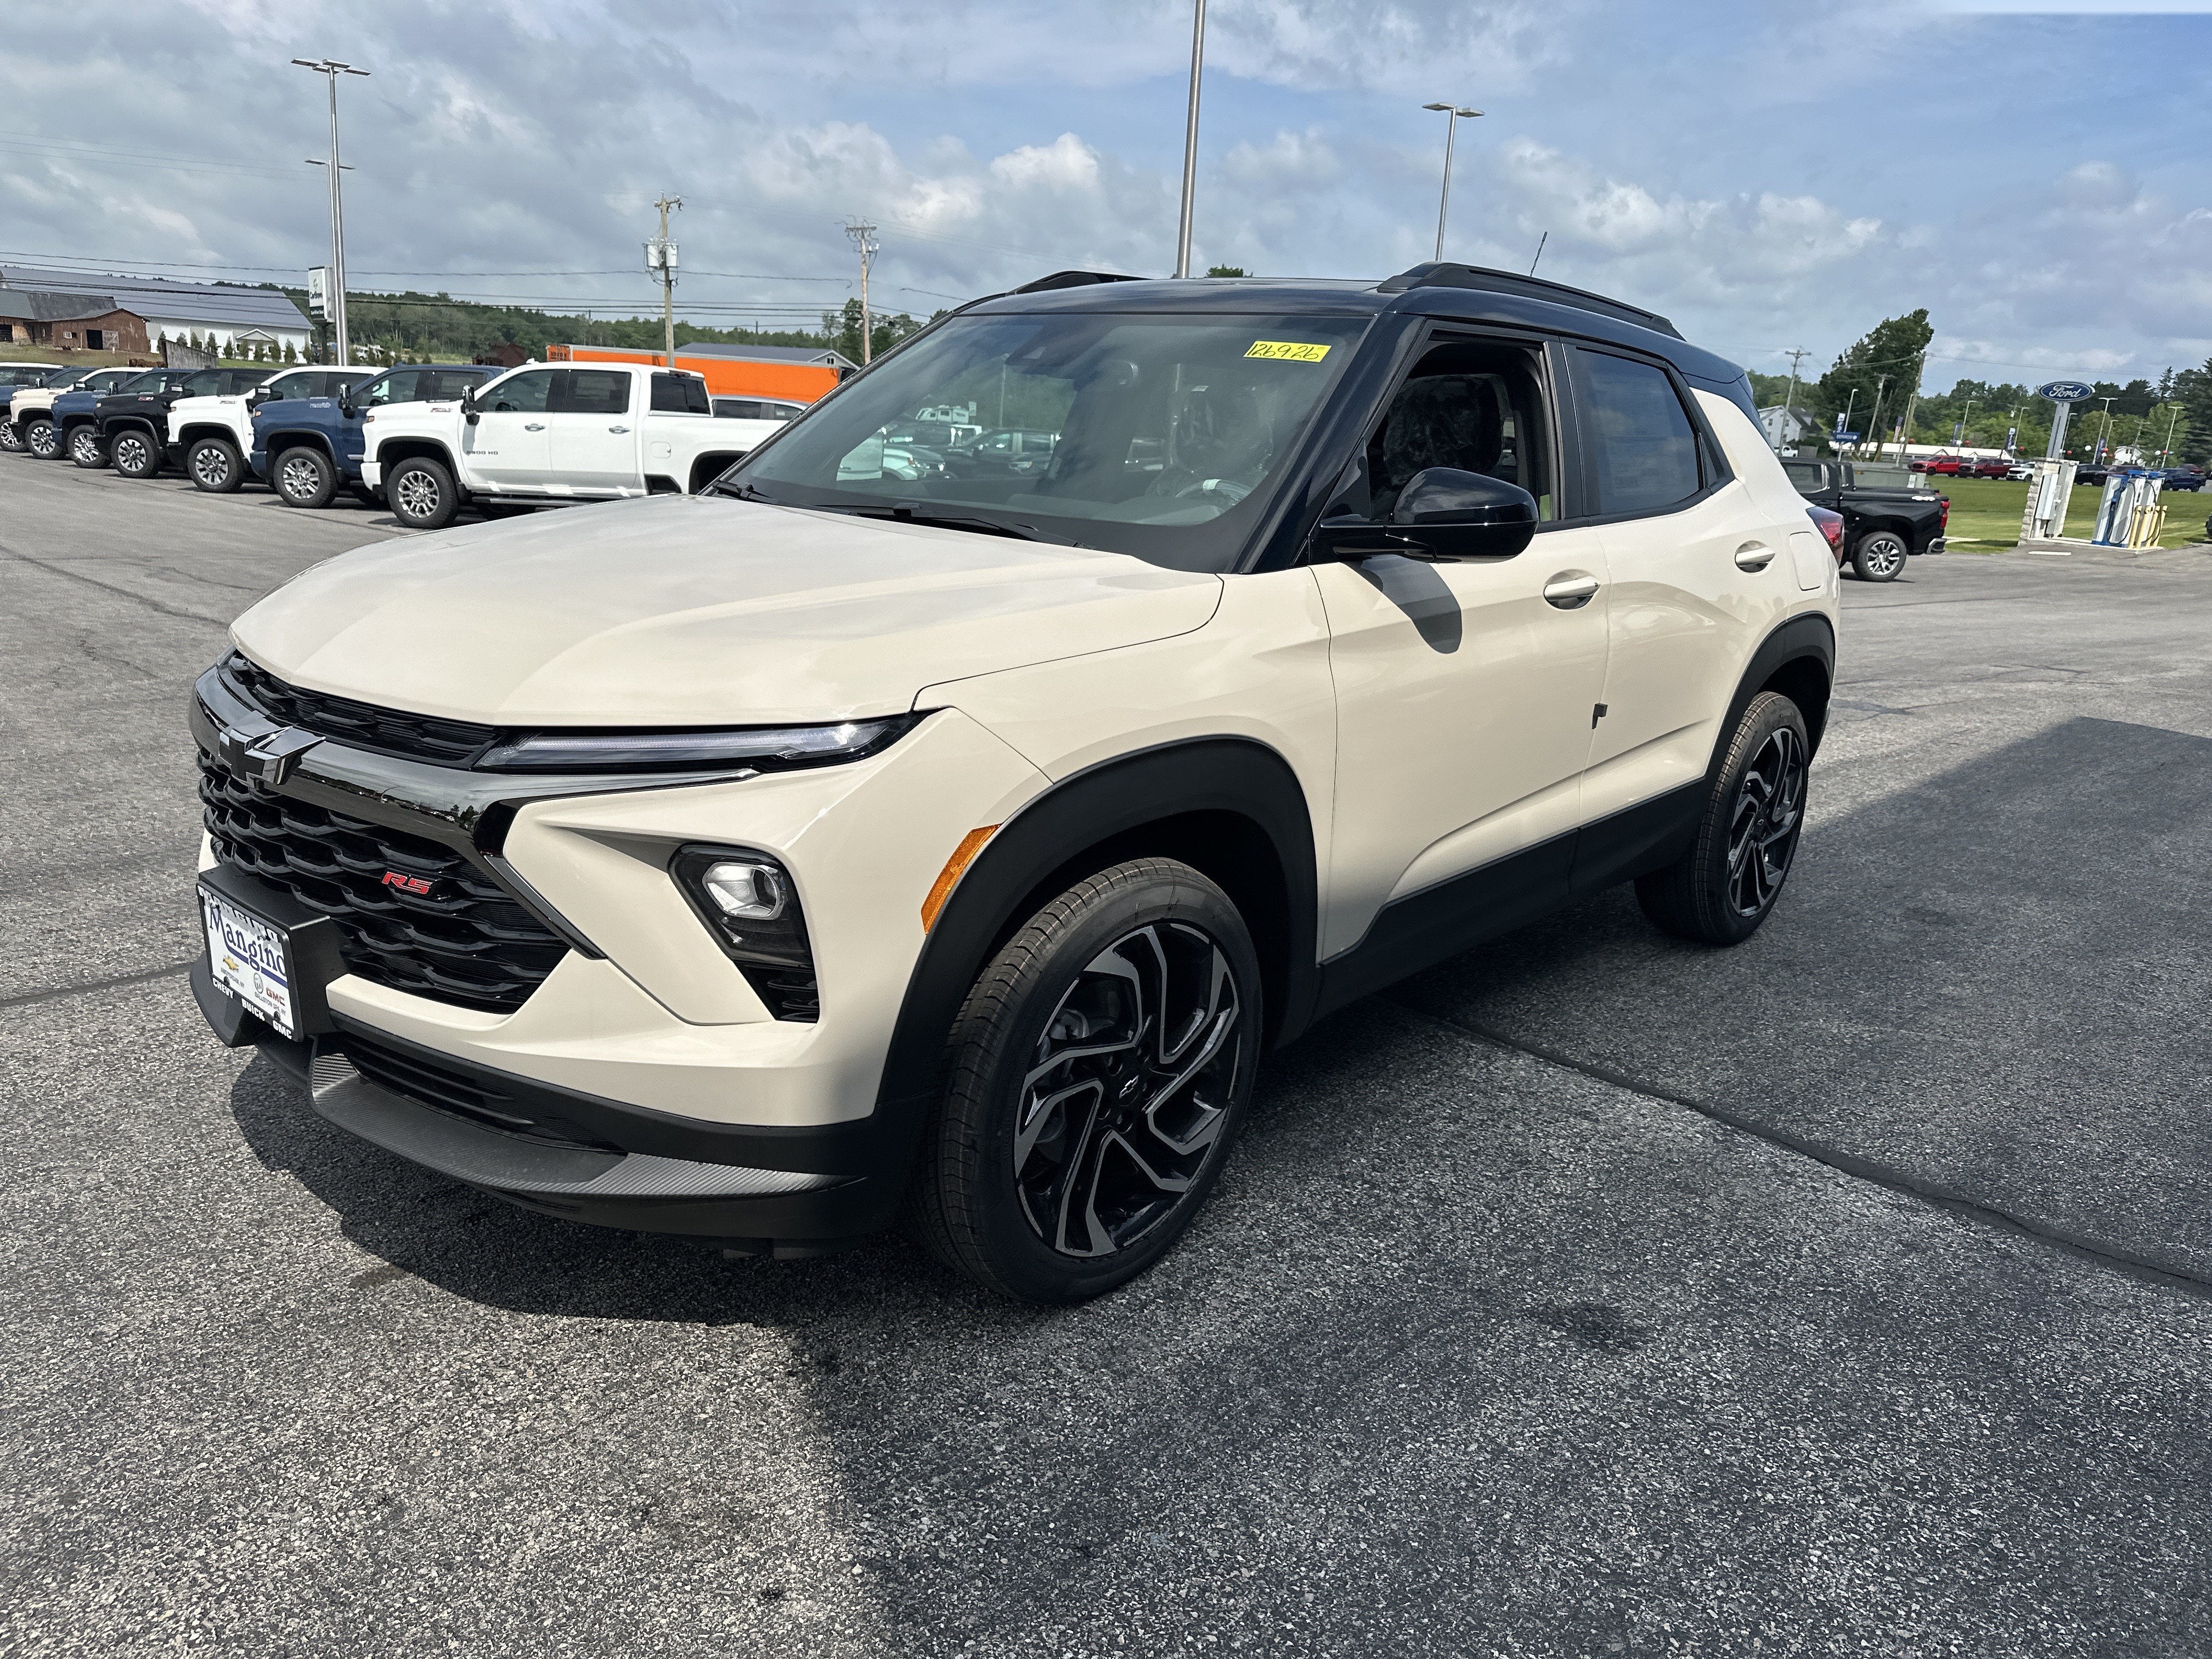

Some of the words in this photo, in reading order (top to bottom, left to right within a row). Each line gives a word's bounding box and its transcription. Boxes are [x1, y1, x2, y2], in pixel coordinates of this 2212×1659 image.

[2049, 385, 2082, 398] Ford
[381, 871, 433, 894] RS
[209, 902, 286, 977] Mangino
[212, 977, 234, 999] CHEVY
[241, 998, 266, 1022] BUICK
[273, 1019, 292, 1040] GMC
[266, 987, 286, 1007] GMC
